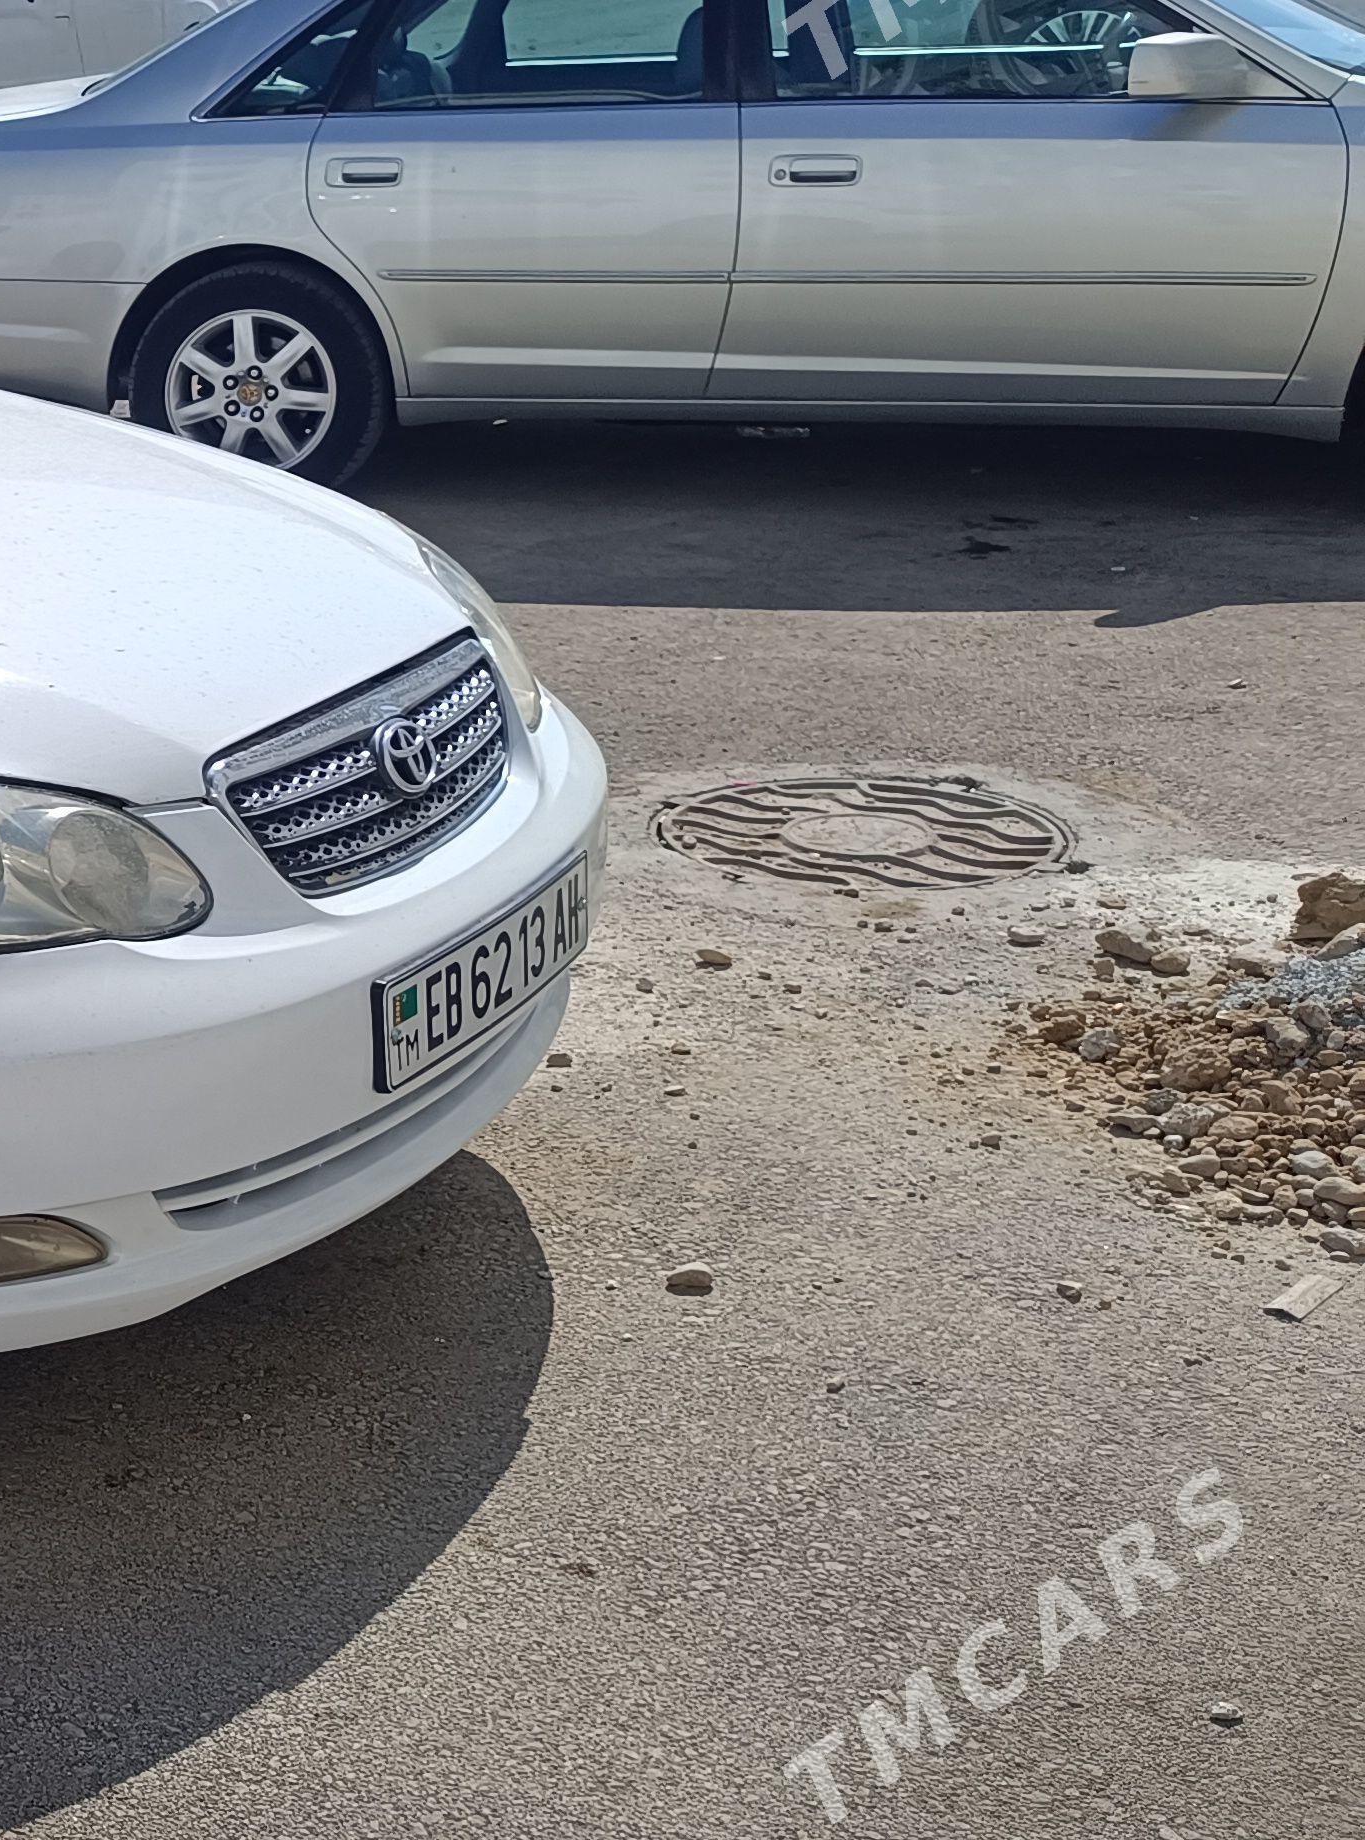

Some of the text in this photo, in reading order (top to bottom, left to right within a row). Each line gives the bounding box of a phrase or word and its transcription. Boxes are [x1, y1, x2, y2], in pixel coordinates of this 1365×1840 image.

[425, 962, 463, 1052] EB
[553, 873, 580, 963] AH
[391, 1028, 420, 1071] TM
